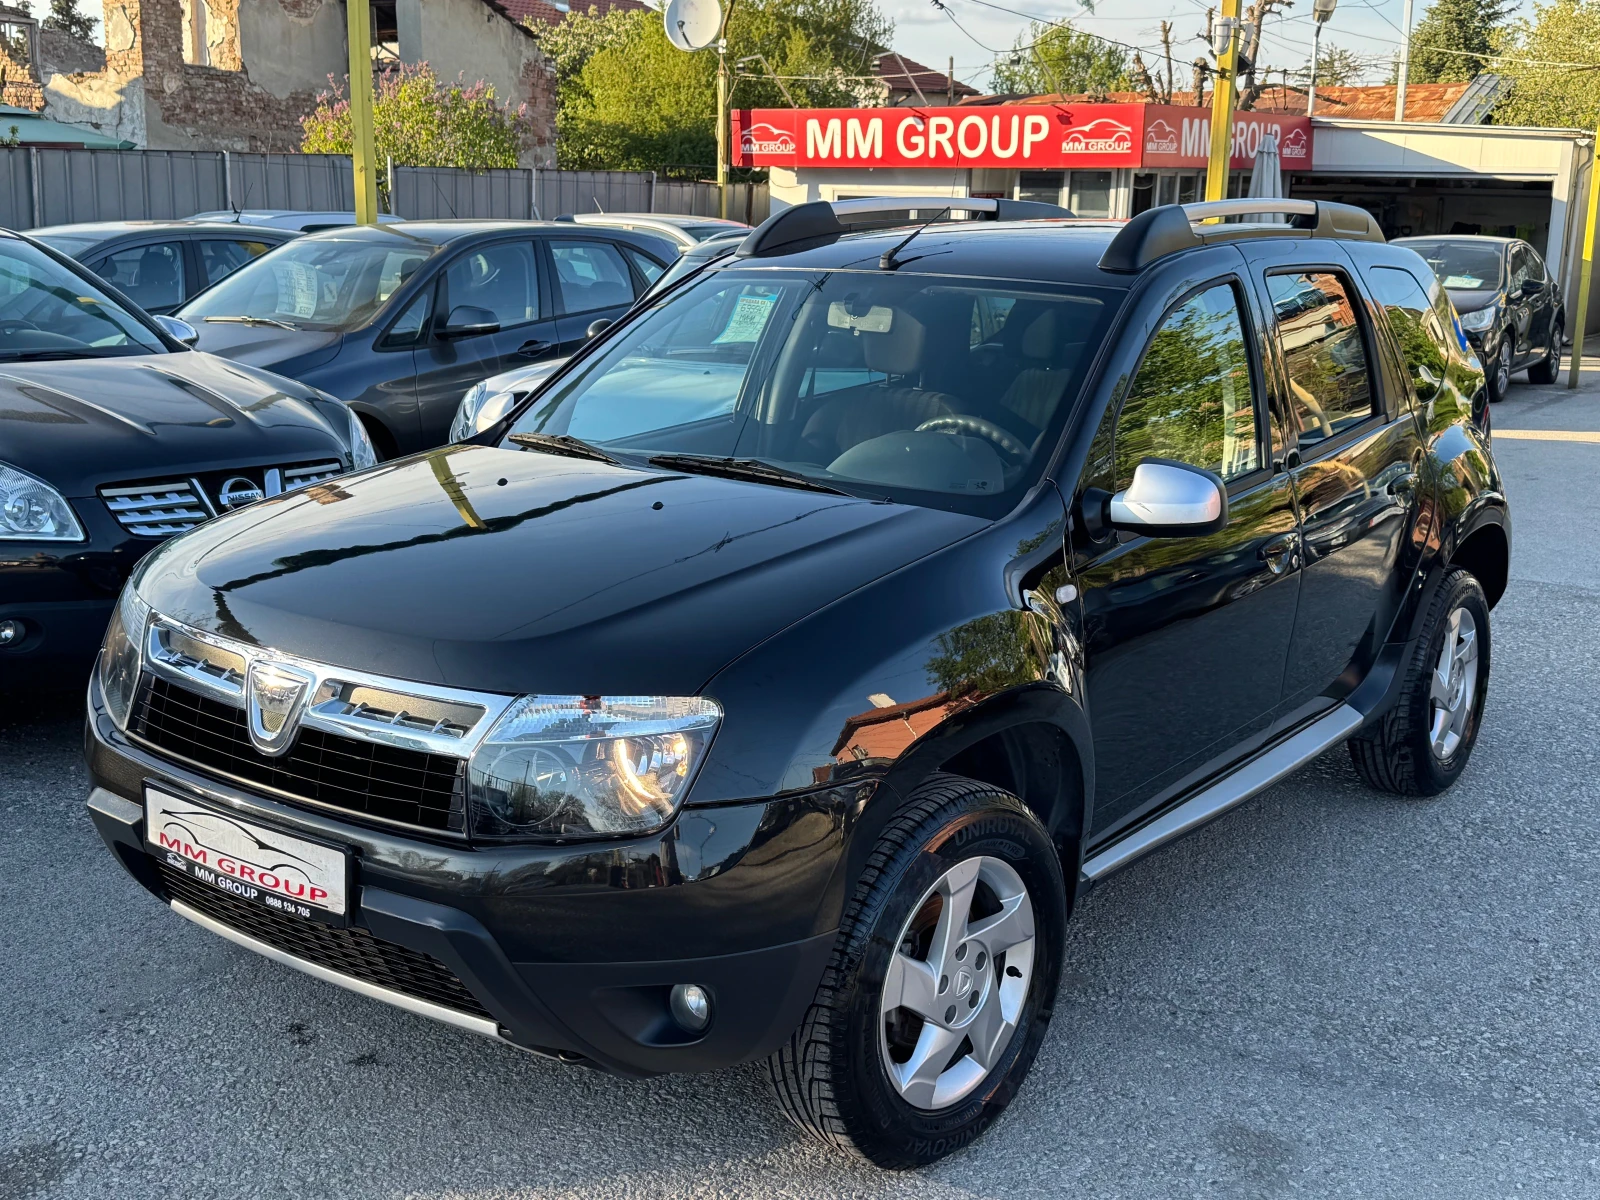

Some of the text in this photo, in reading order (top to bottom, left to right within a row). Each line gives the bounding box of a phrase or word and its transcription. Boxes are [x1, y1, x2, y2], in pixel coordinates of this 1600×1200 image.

[741, 144, 796, 152] MM GROUP
[806, 115, 1049, 159] MM GROUP
[1062, 141, 1132, 151] MM GROUP
[1146, 142, 1178, 151] MM GROUP
[227, 492, 261, 502] NISSAN
[955, 816, 1032, 847] UNIROYAL
[160, 832, 328, 901] MM GROUP
[194, 866, 311, 918] MM GROUP 0888 936 705
[904, 1117, 988, 1156] UNIROYAL
